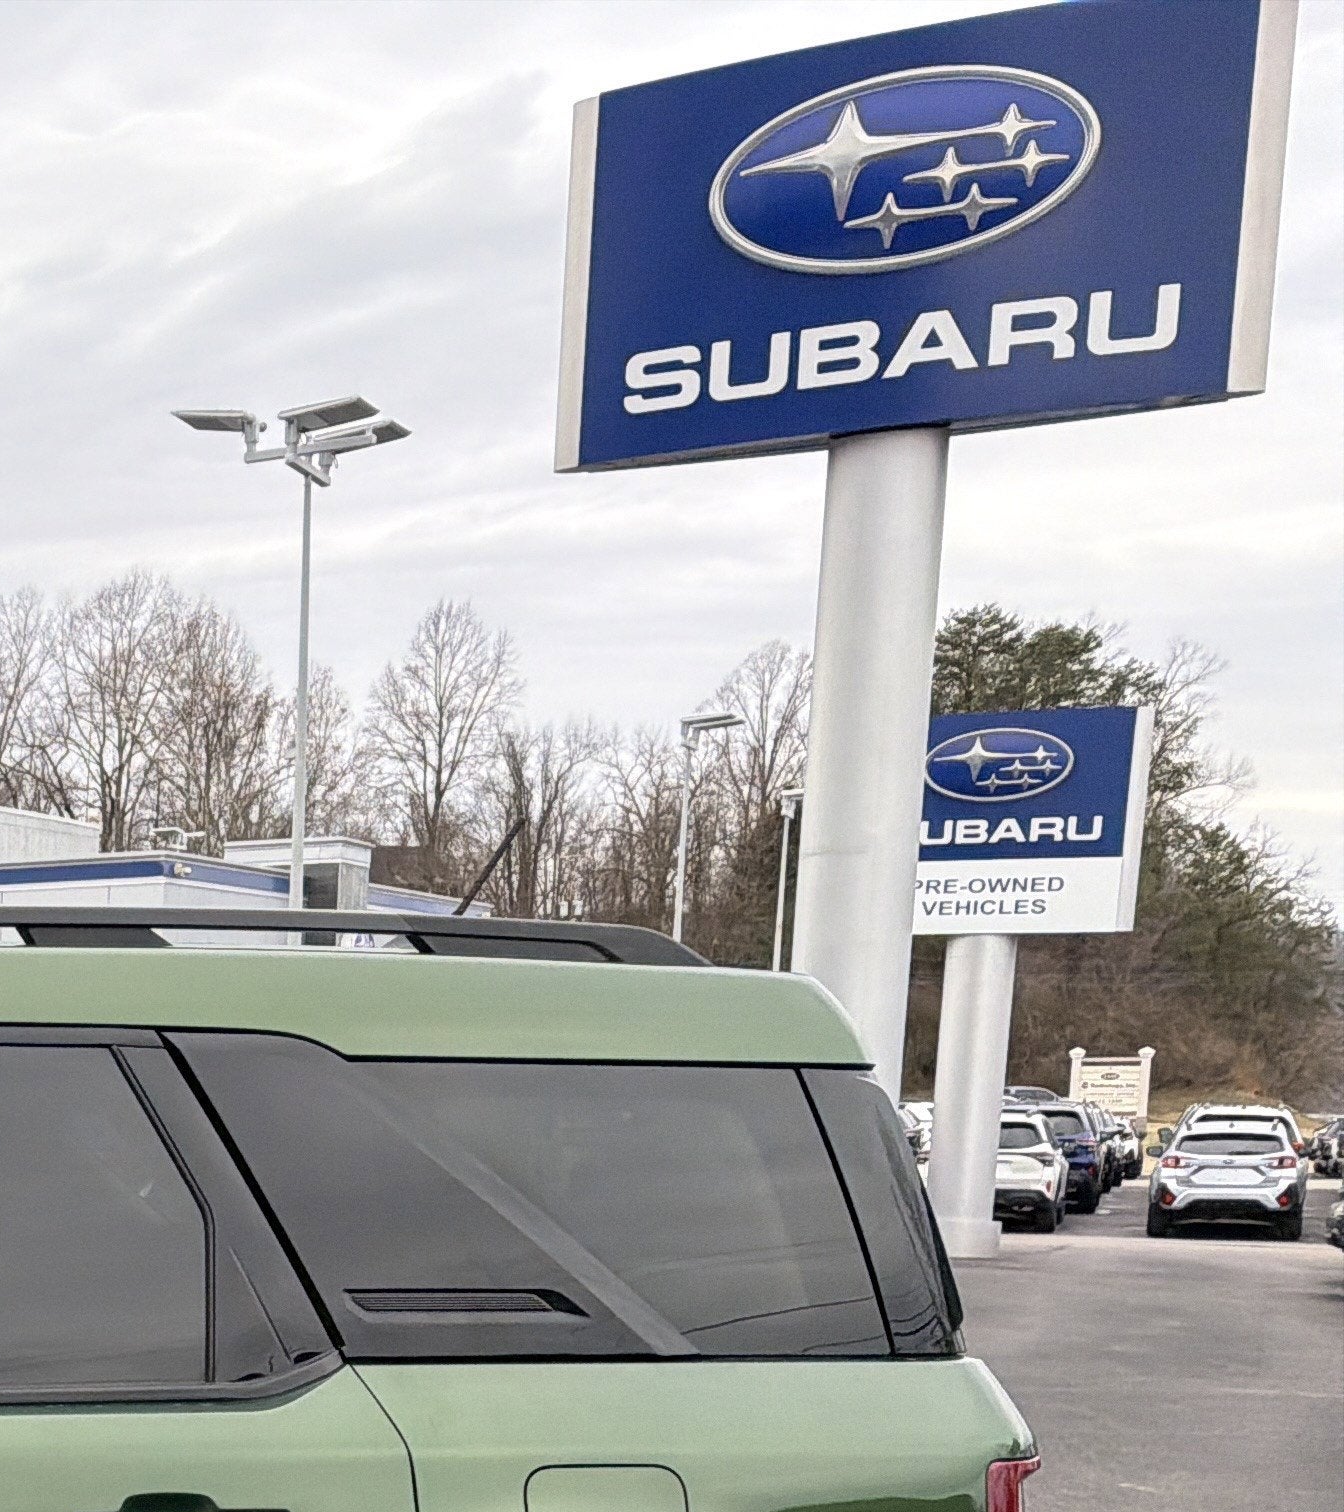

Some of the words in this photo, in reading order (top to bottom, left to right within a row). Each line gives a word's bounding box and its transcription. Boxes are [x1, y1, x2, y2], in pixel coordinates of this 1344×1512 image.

[623, 282, 1182, 415] SUBARU
[919, 815, 1103, 846] UBARU
[914, 876, 1065, 895] PRE-OWNED
[922, 898, 1047, 916] VEHICLES
